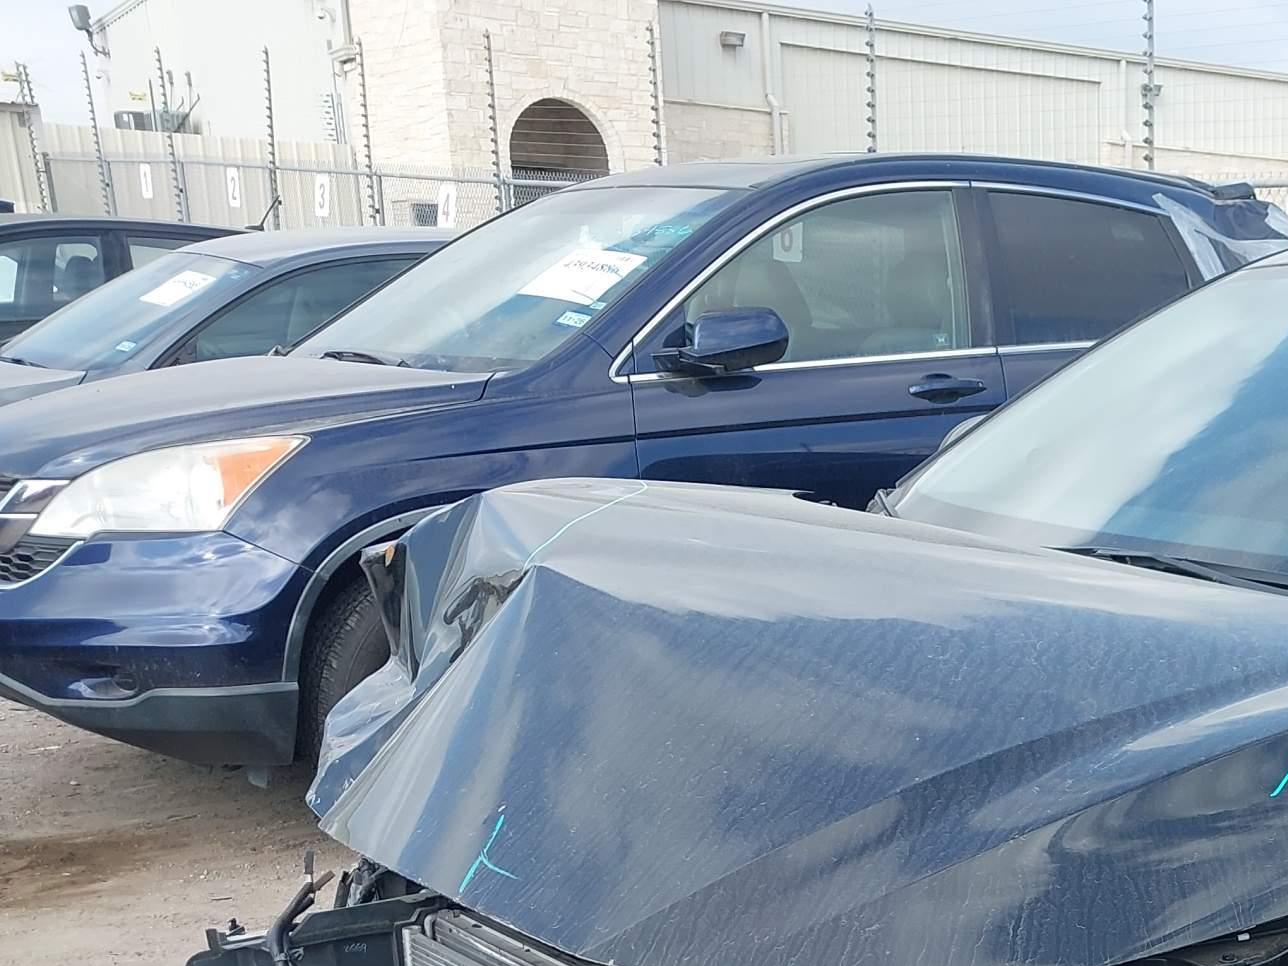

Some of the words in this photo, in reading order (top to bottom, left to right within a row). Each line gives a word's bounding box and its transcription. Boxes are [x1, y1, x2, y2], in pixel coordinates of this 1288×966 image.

[230, 175, 238, 201] 2
[318, 183, 326, 209] 3
[441, 192, 450, 223] 4
